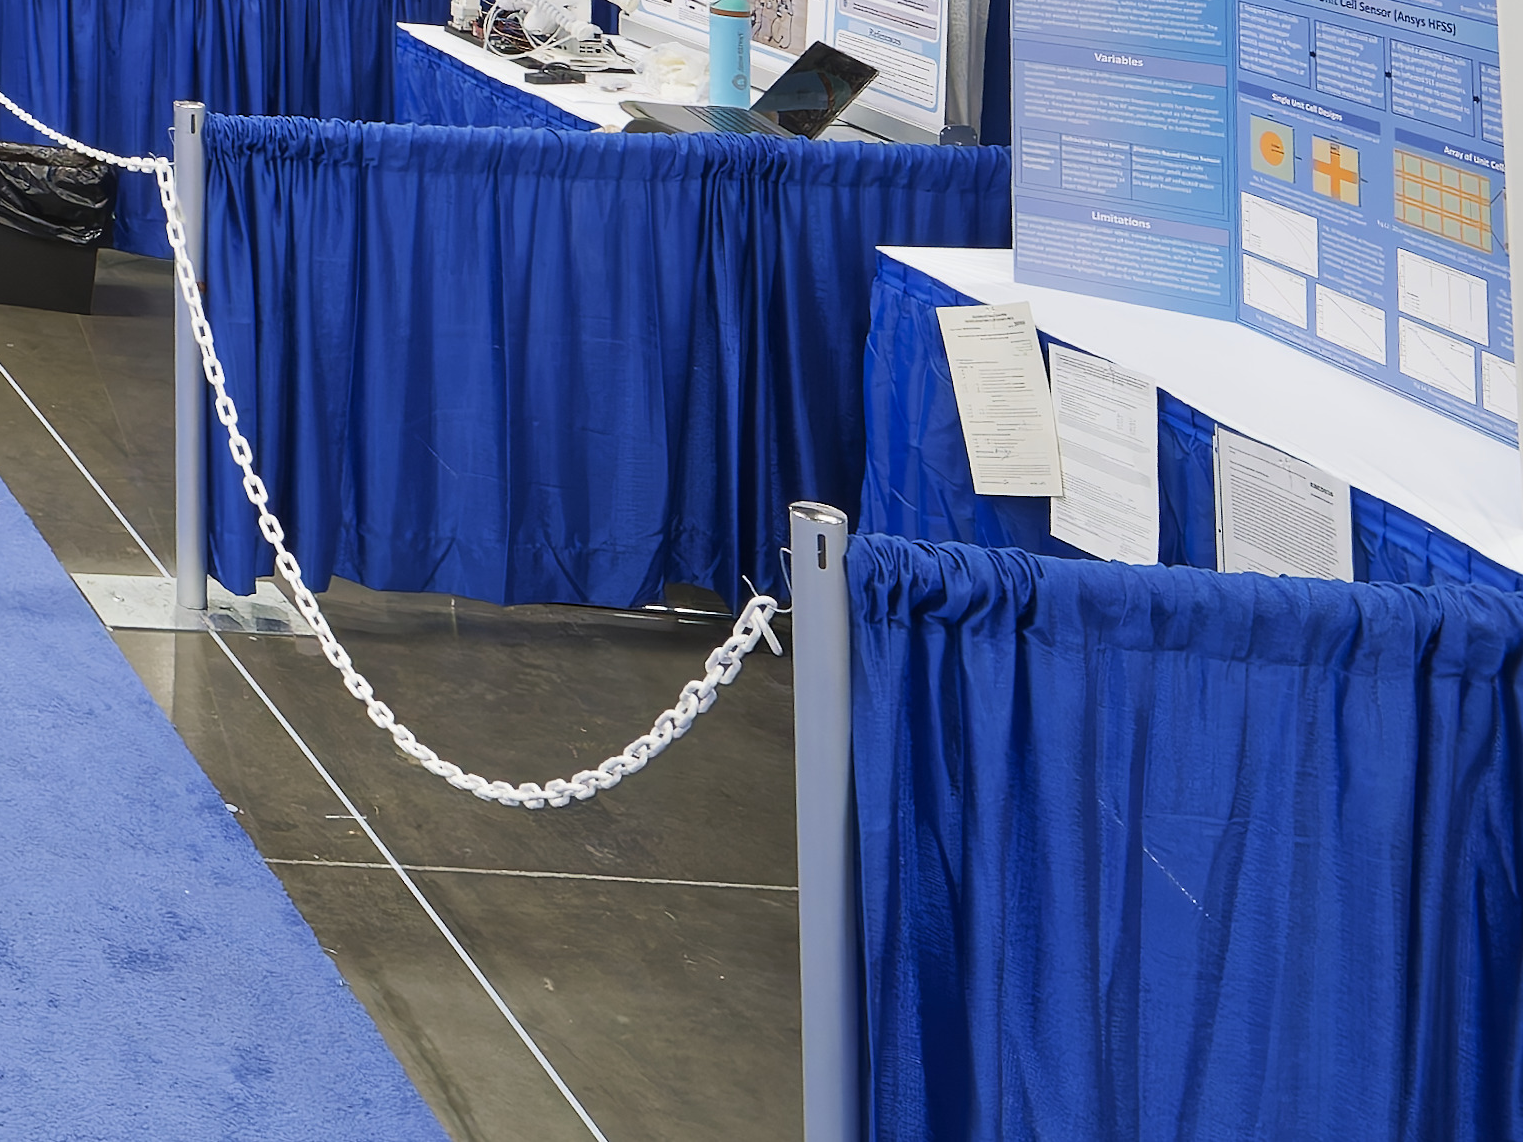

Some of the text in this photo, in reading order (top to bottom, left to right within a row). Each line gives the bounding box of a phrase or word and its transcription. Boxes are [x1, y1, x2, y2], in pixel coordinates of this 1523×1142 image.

[1359, 1, 1392, 18] Sensor
[1393, 8, 1425, 28] (Ansys
[1428, 16, 1456, 36] HFSS)
[868, 27, 902, 46] References
[1094, 52, 1144, 67] Variables
[1271, 93, 1342, 122] Single Unit Cell Designs
[1444, 145, 1463, 161] Array
[1464, 151, 1472, 161] of
[1091, 210, 1151, 229] Limitations
